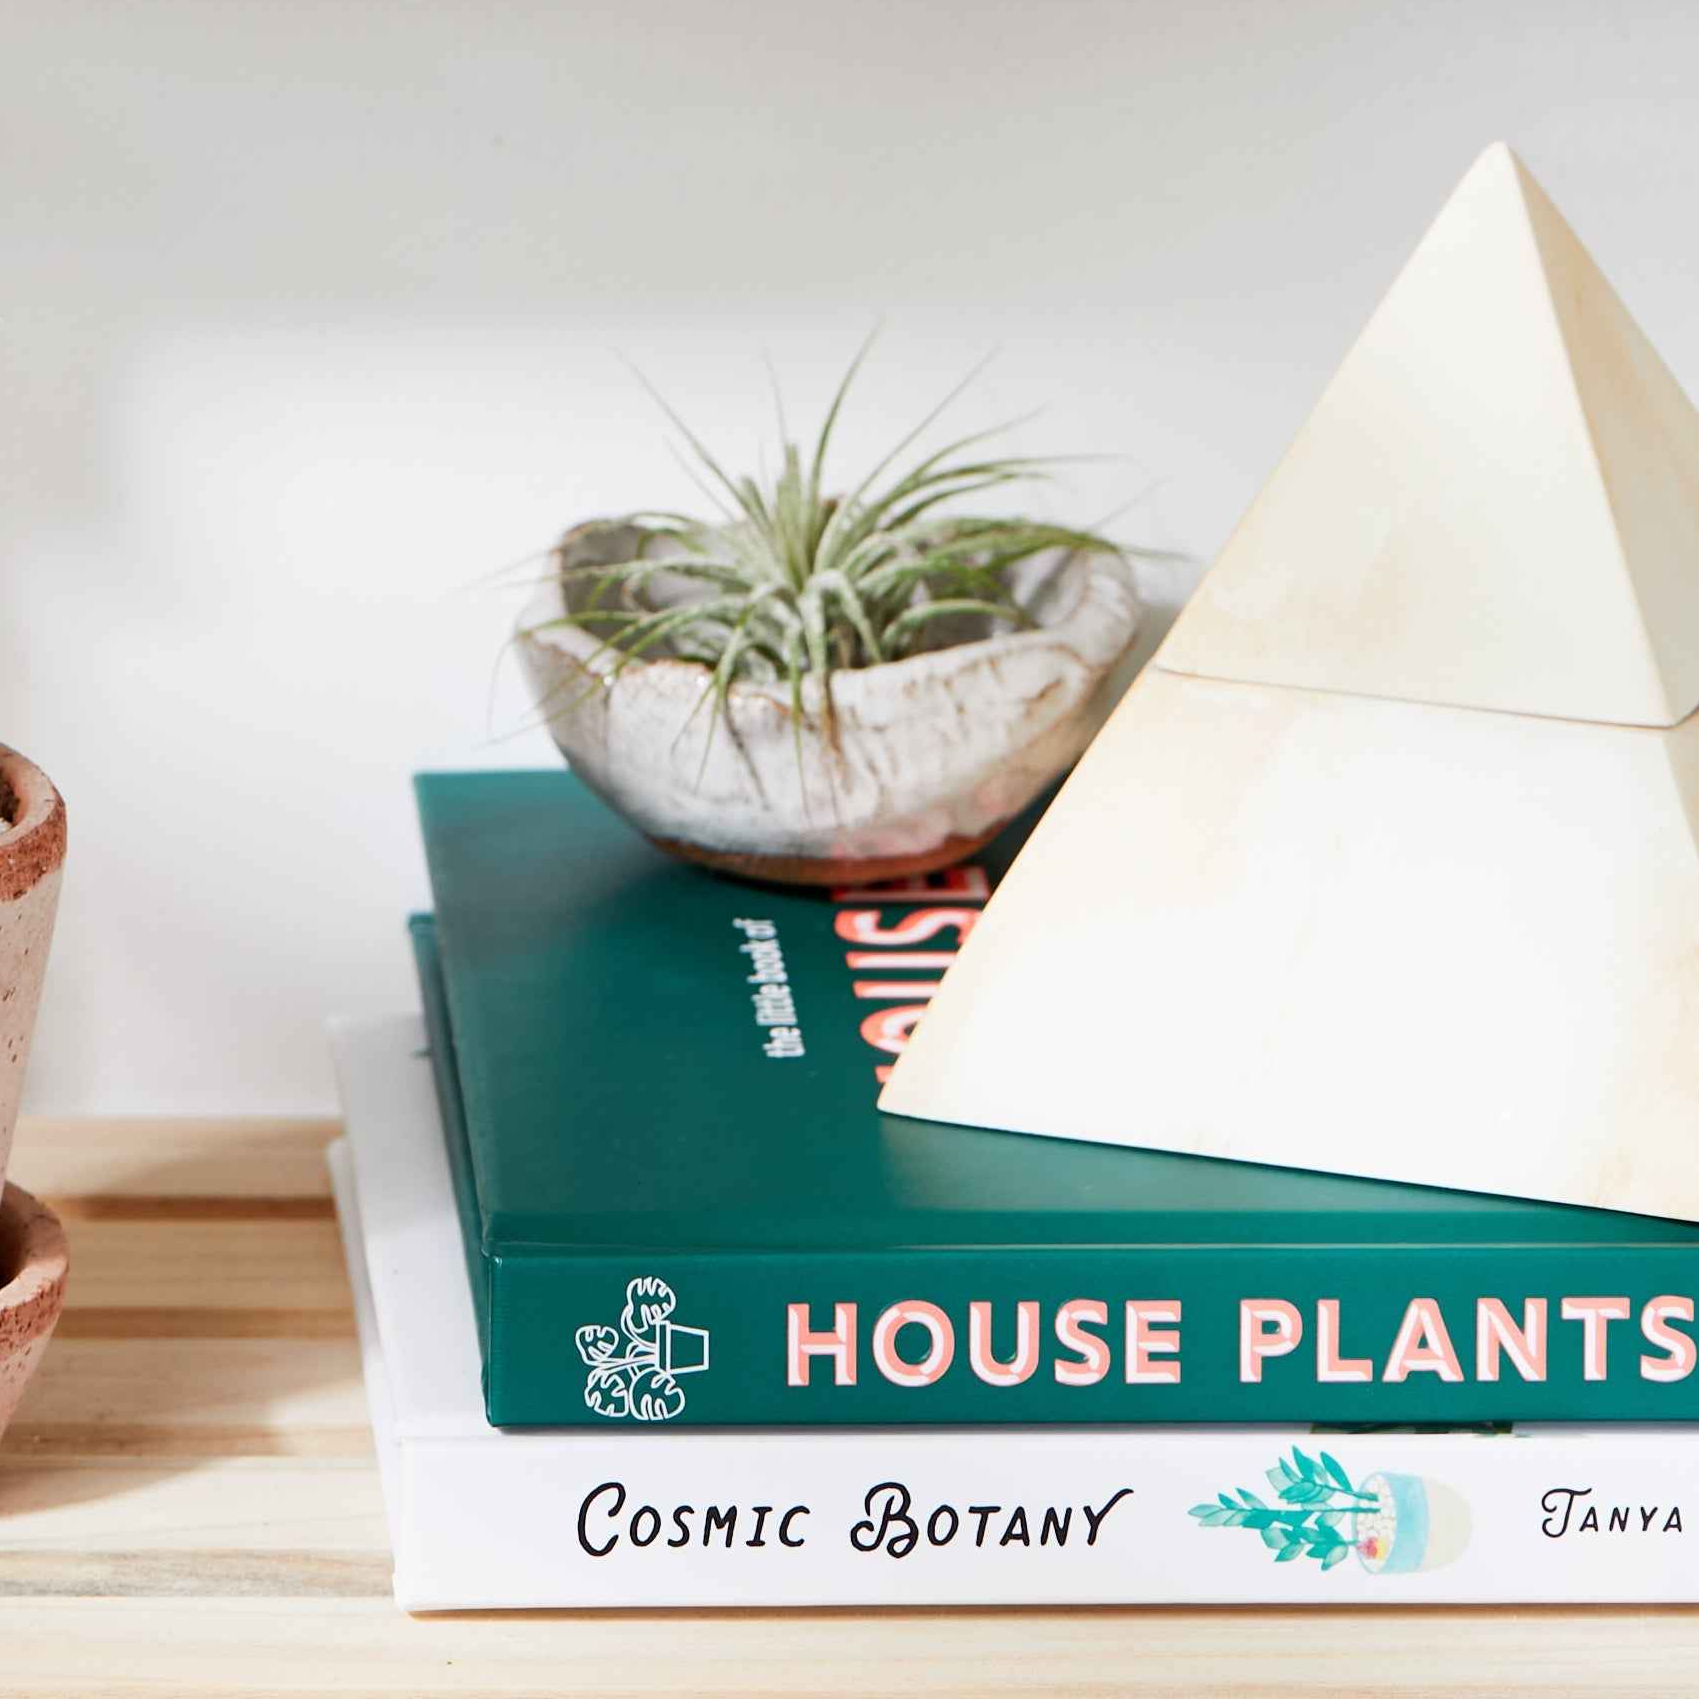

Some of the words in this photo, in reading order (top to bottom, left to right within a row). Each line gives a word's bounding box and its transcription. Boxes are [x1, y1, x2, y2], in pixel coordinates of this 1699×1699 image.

[732, 917, 777, 940] of
[738, 938, 788, 984] book
[750, 983, 798, 1027] little
[761, 1026, 805, 1058] the
[786, 1298, 1183, 1388] HOUSE
[1239, 1294, 1698, 1383] PLANTS
[577, 1481, 811, 1557] COSMIC
[850, 1481, 1135, 1559] BOTANY
[1541, 1487, 1684, 1538] TANYA
